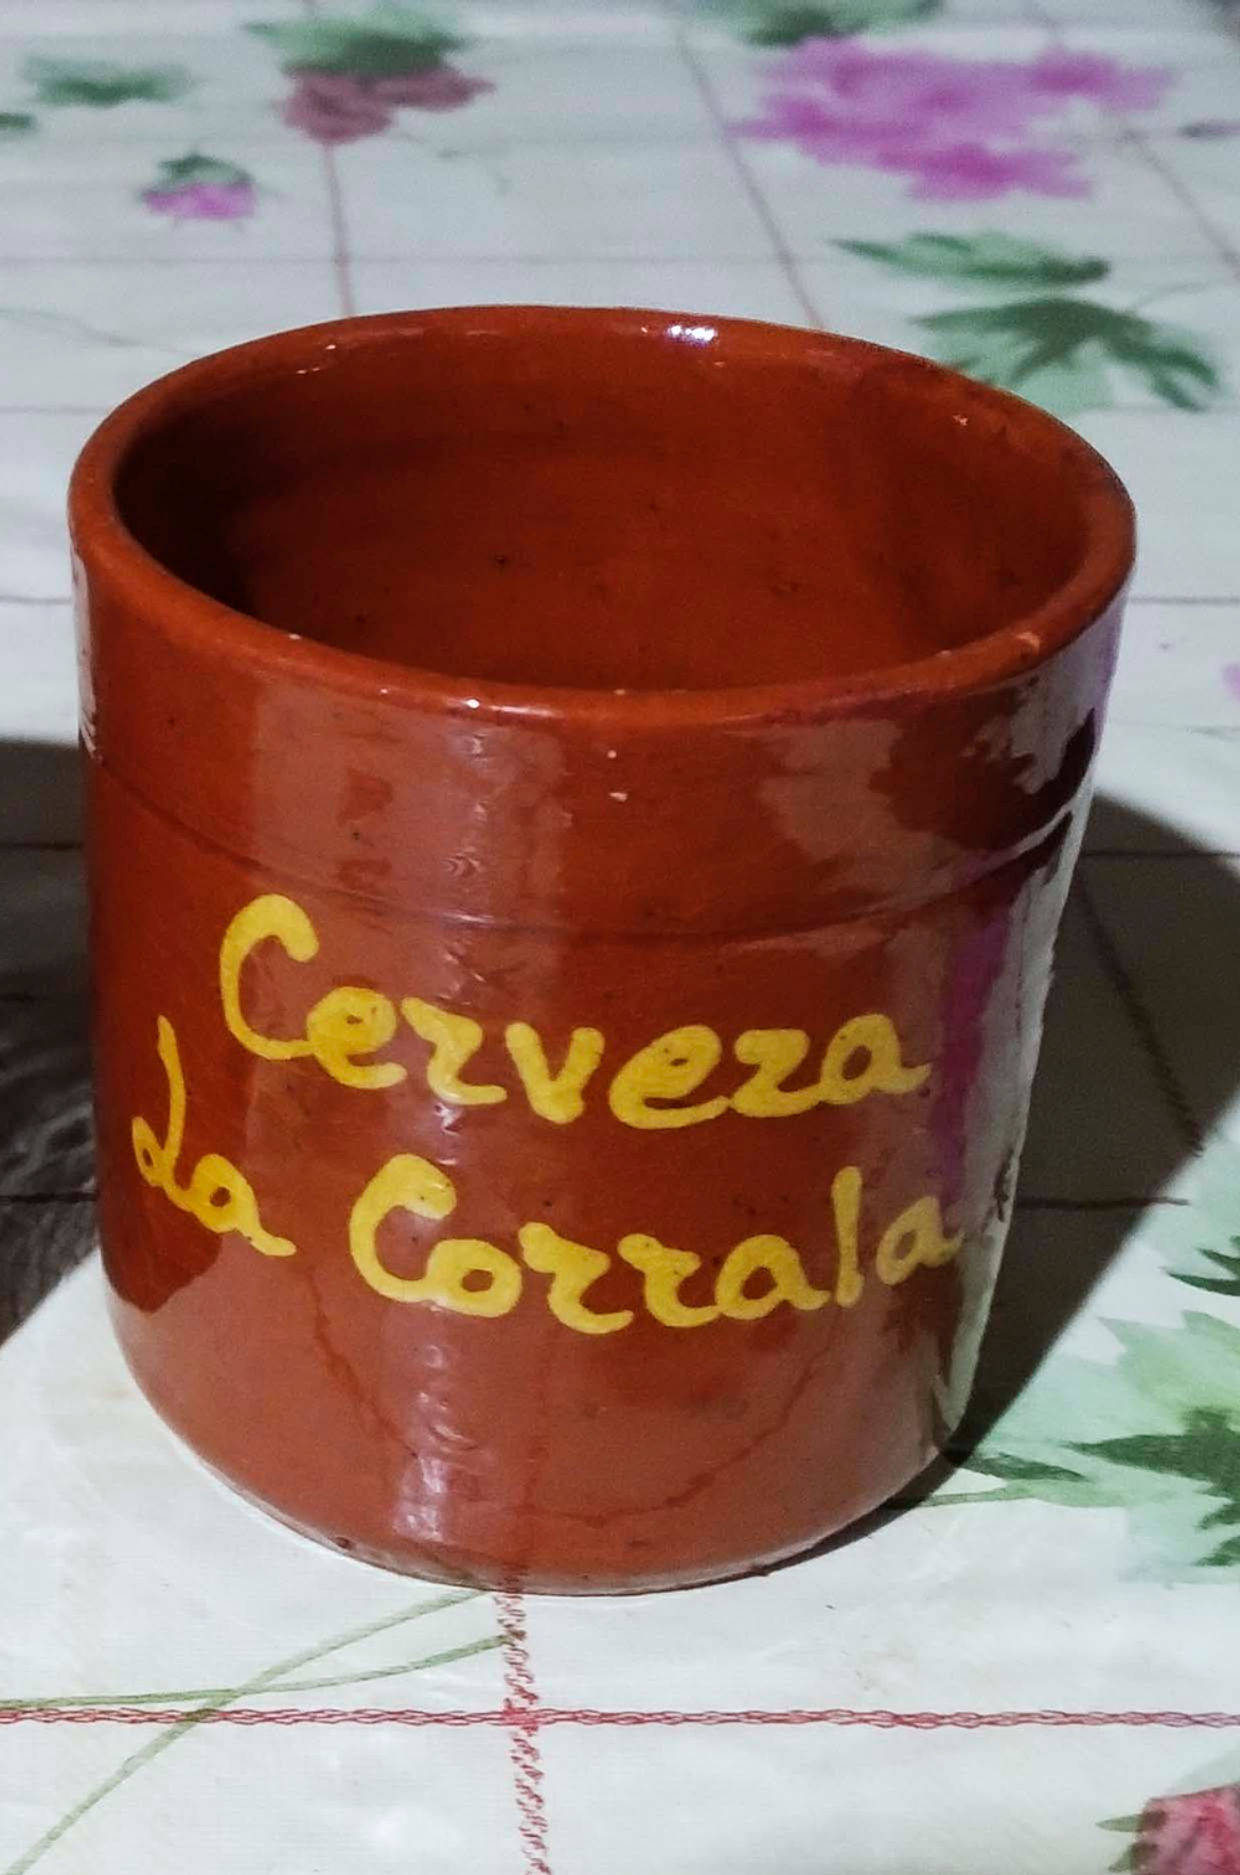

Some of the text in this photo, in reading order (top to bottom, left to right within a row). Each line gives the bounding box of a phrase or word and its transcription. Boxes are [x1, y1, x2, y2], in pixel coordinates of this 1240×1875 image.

[219, 893, 931, 1130] Cerveza
[131, 1014, 964, 1335] La Corrala
